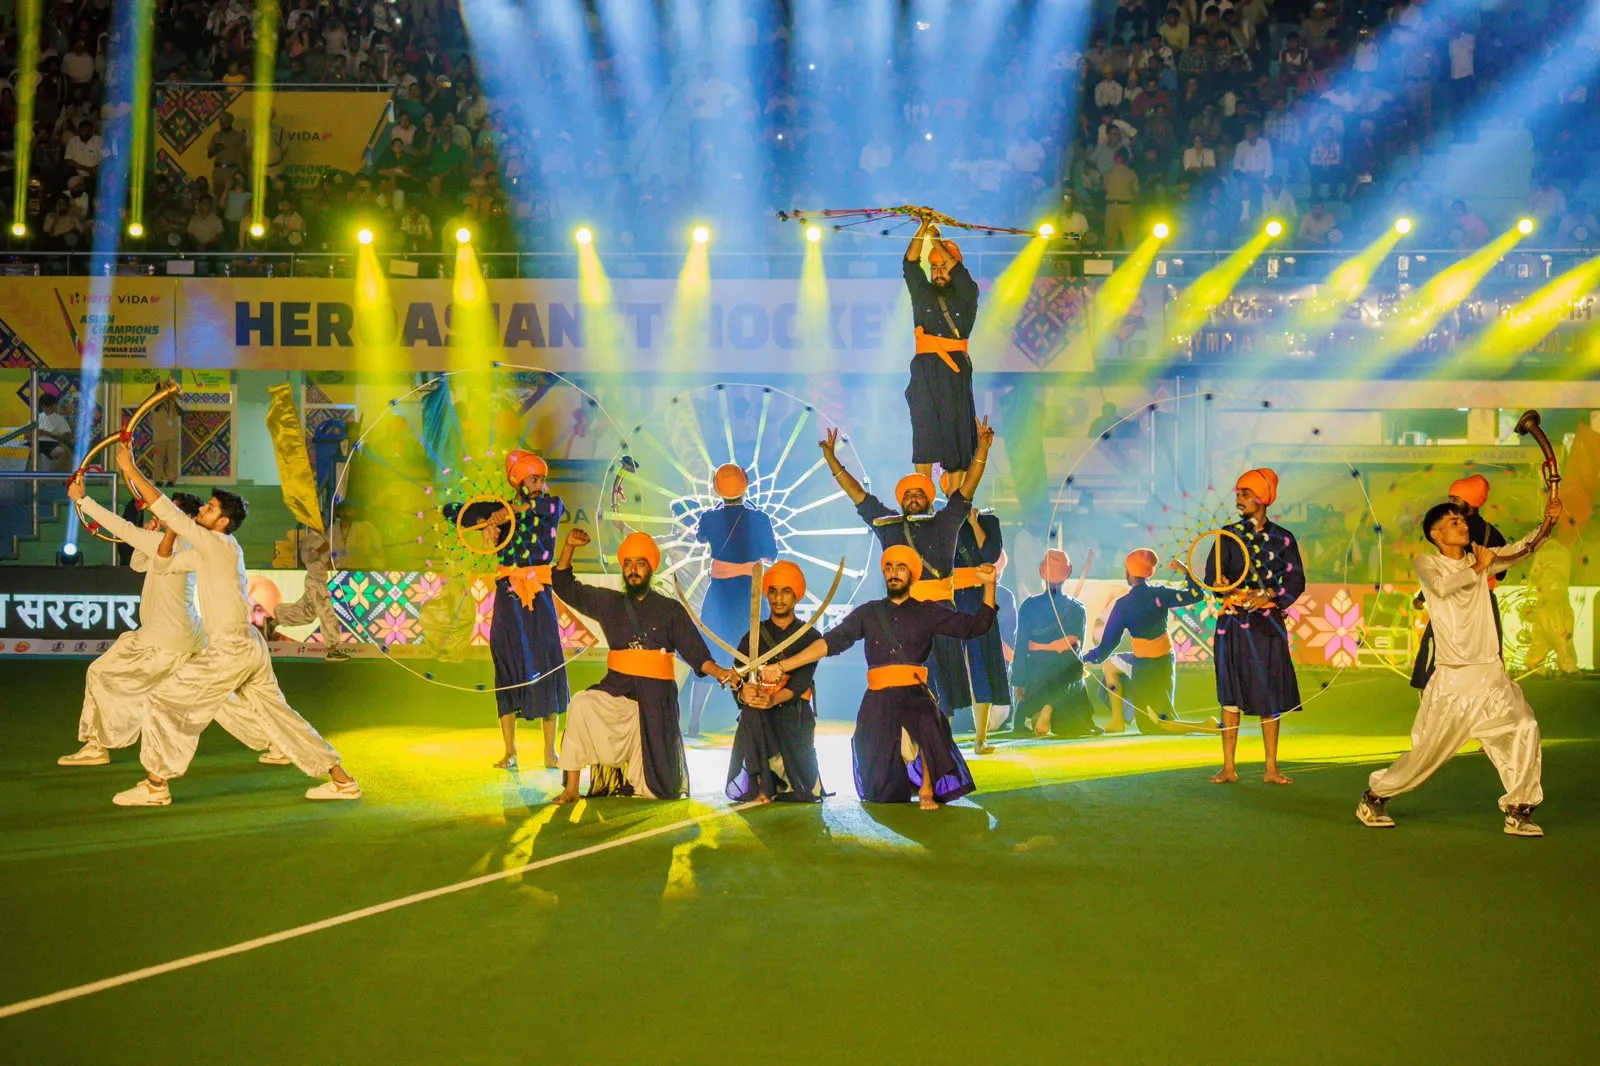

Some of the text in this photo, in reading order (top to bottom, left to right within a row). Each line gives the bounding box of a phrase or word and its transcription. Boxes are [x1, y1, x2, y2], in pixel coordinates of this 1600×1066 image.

[288, 131, 320, 141] VIDA
[117, 295, 149, 304] VIDA
[235, 302, 398, 348] HERO
[685, 301, 898, 350] HOCKE
[102, 336, 147, 345] TROPHY
[13, 594, 140, 631] सरकार
